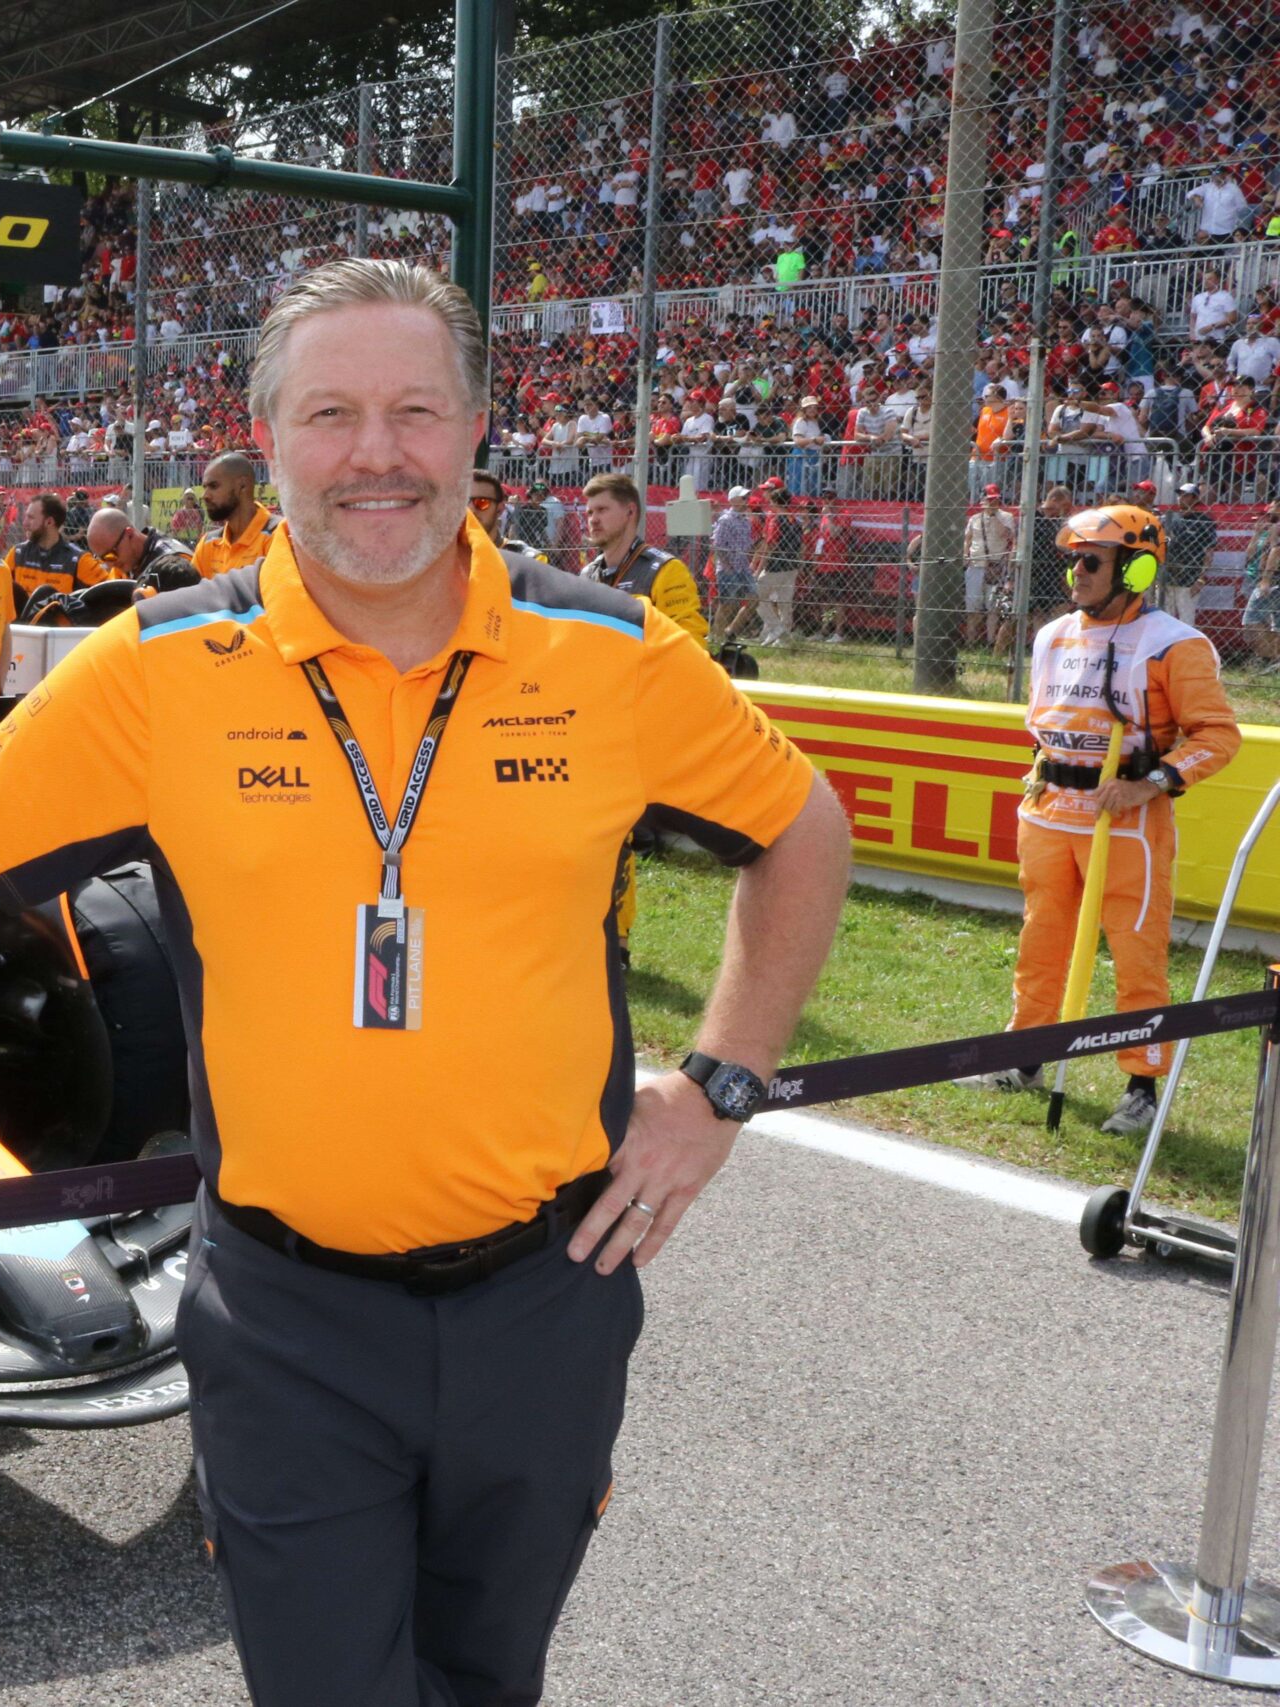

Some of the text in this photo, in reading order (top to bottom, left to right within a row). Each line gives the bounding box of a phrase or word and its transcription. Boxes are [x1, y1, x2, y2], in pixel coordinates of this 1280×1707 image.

[215, 649, 254, 668] CASTORE
[520, 682, 540, 694] Zak
[482, 715, 566, 728] McLaren
[227, 728, 284, 740] android
[238, 766, 310, 789] DELL
[494, 758, 570, 782] OKX
[347, 742, 386, 831] GRID ACCESS
[398, 740, 433, 829] GRID ACCESS
[240, 792, 312, 806] Technologies
[408, 938, 422, 982] LANE
[408, 984, 421, 1010] PIT
[1067, 1026, 1153, 1052] McLaren
[767, 1075, 803, 1100] flex
